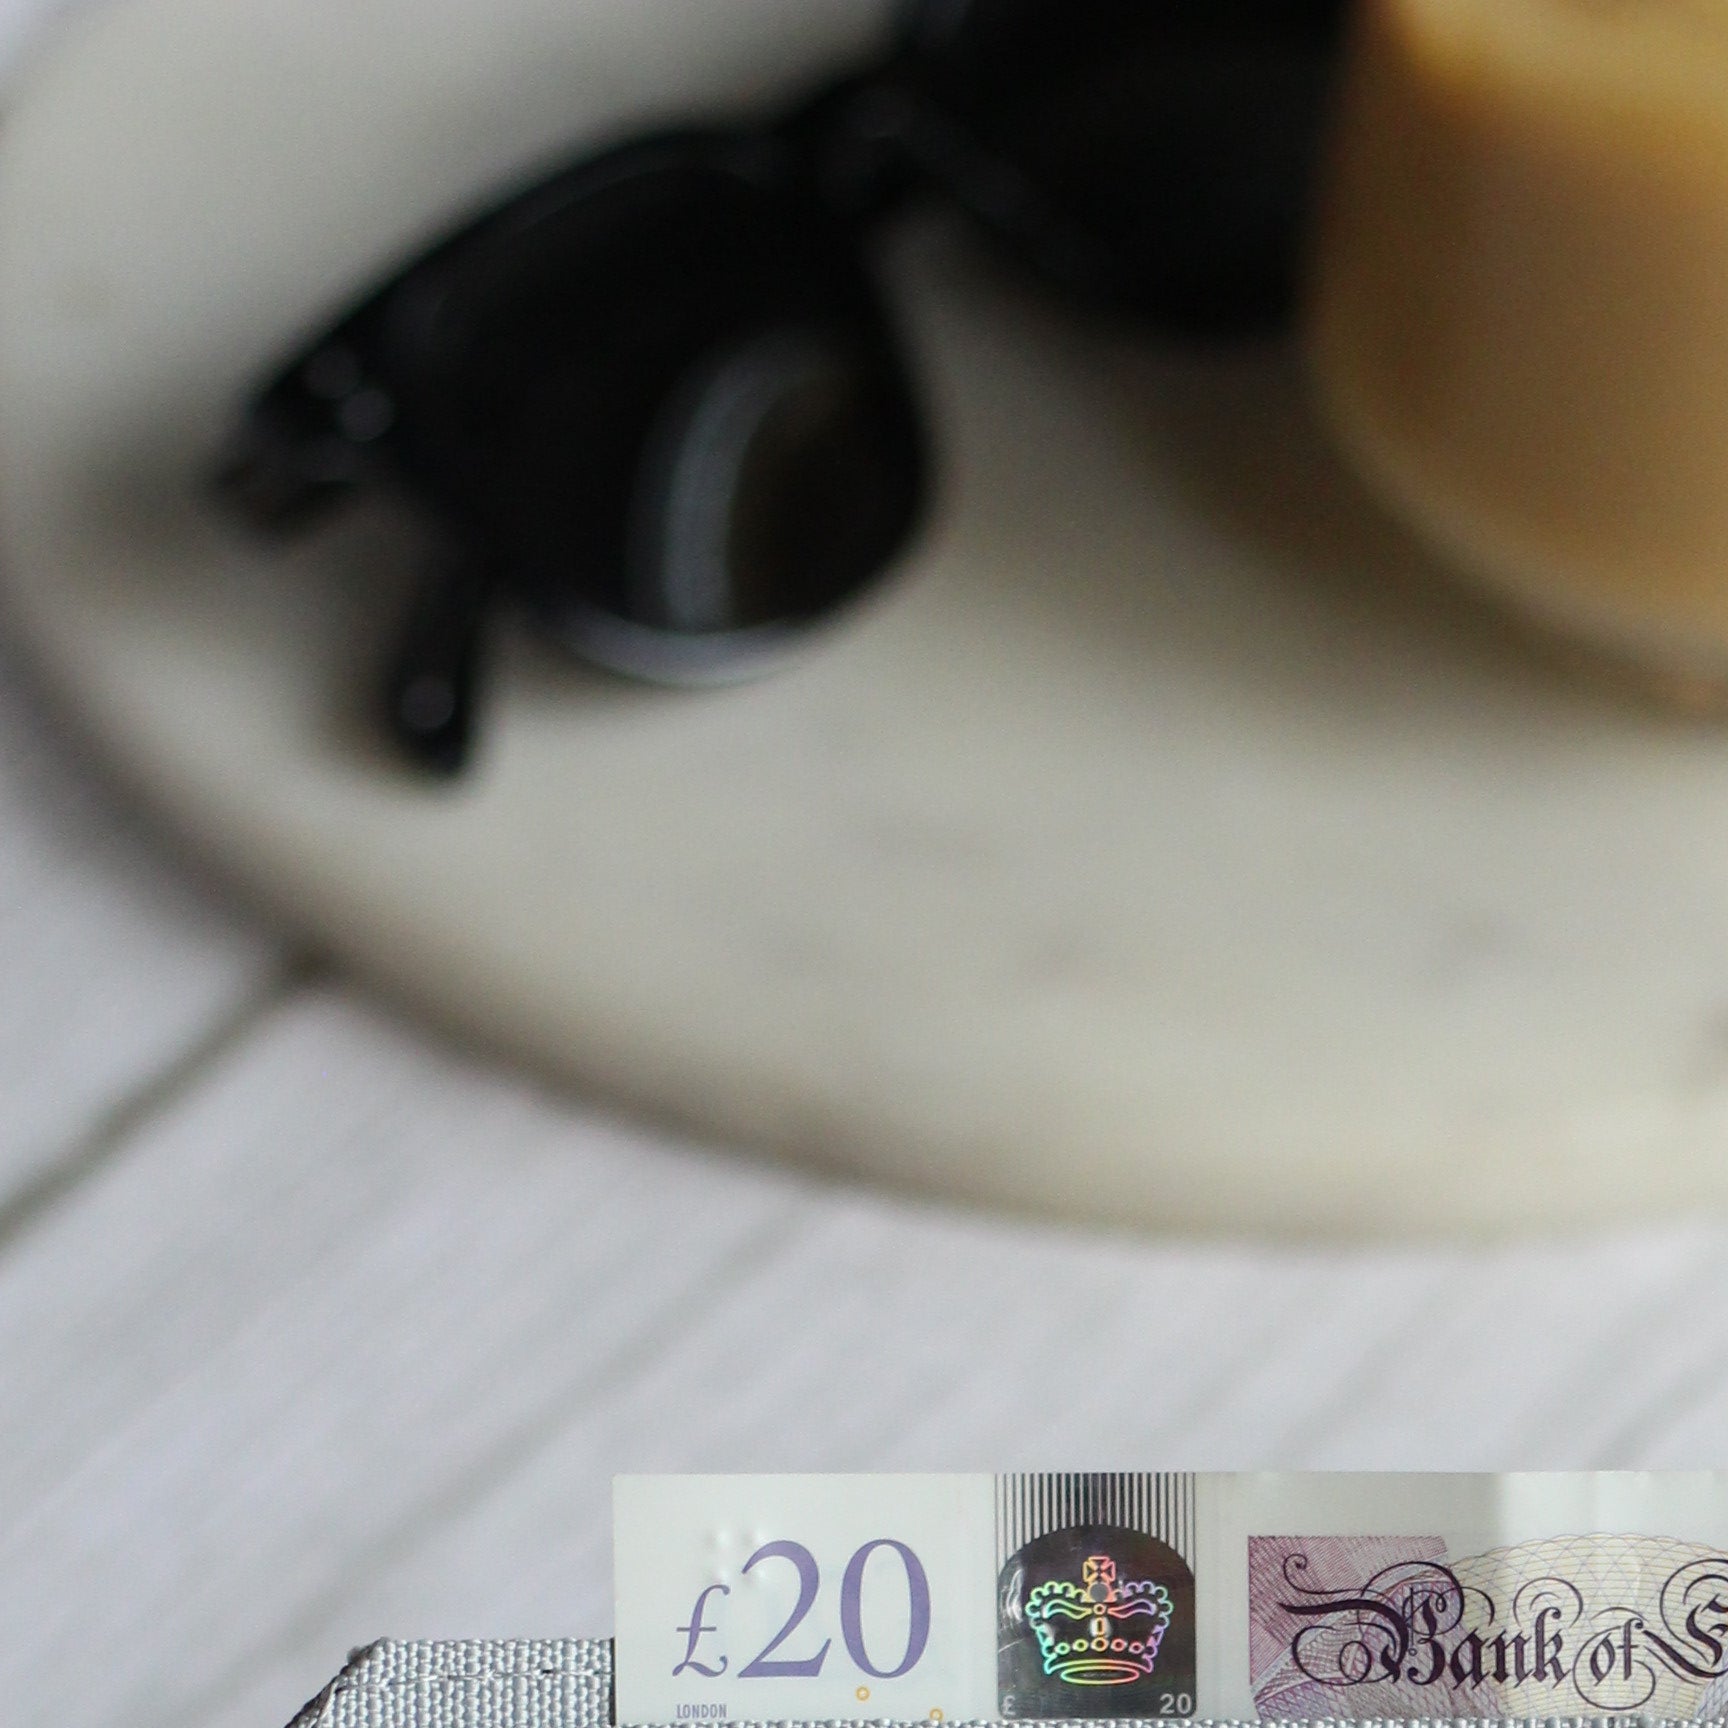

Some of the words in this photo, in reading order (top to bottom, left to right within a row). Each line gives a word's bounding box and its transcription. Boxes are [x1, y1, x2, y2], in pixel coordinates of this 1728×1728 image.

[672, 1539, 931, 1680] £20
[1278, 1554, 1583, 1690] Bank
[676, 1703, 728, 1719] LONDON
[1159, 1692, 1192, 1714] 20
